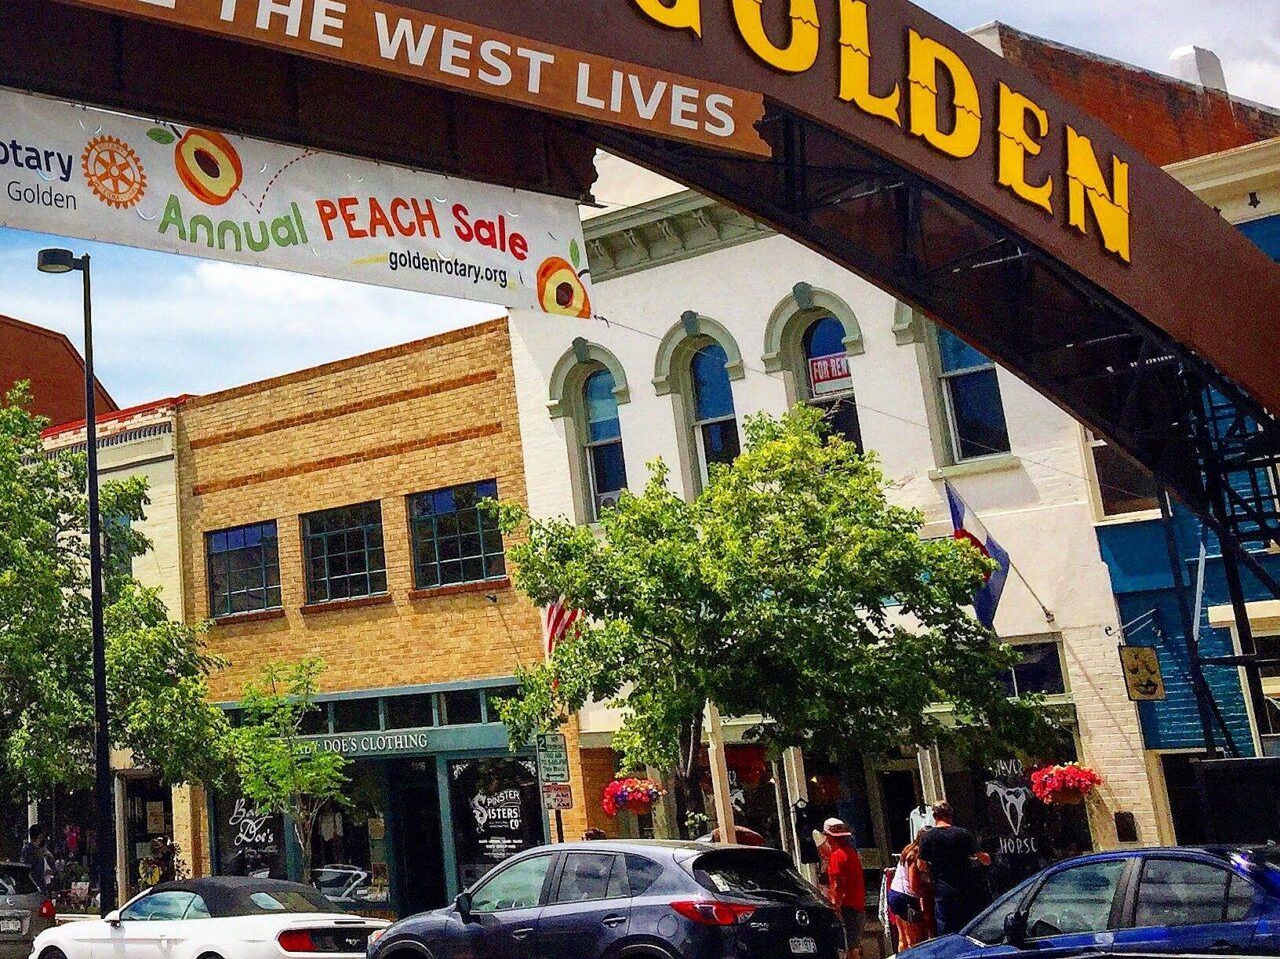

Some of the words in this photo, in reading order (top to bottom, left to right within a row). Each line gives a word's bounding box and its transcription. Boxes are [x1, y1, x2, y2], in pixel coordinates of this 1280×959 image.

[374, 10, 554, 96] WEST
[576, 61, 736, 138] LIVES
[6, 179, 78, 211] Golden
[157, 193, 308, 252] Annual
[316, 196, 439, 243] PEACH
[453, 203, 529, 261] Sale
[388, 249, 508, 289] goldenrotary.org
[813, 360, 830, 381] FOR
[830, 357, 850, 377] REN
[324, 736, 358, 753] DOE'S
[361, 734, 428, 750] CLOTHING
[538, 737, 546, 750] 2
[234, 819, 274, 845] Doe's
[999, 837, 1038, 854] HORSE
